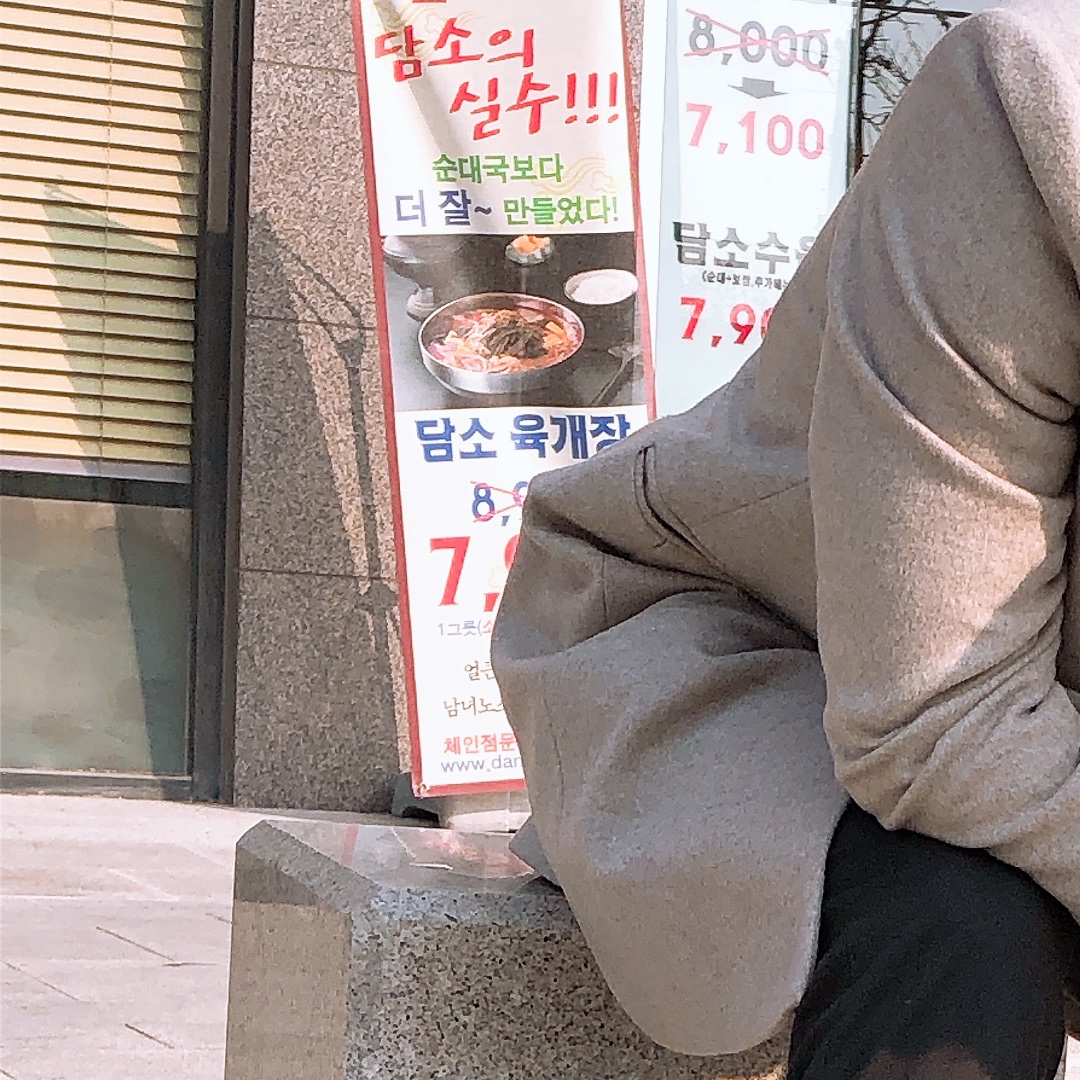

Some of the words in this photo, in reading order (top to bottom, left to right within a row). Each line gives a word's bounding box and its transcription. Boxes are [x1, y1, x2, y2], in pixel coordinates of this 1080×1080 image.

[375, 17, 534, 81] 담소의
[689, 15, 829, 68] 8,000
[450, 72, 619, 140] 실수!!!
[685, 104, 825, 160] 7,100
[432, 152, 564, 183] 순대국보다
[396, 192, 426, 227] 더
[504, 196, 619, 225] 만들었다!
[415, 418, 497, 462] 담소
[510, 414, 630, 459] 육개장
[430, 536, 520, 612] 7,
